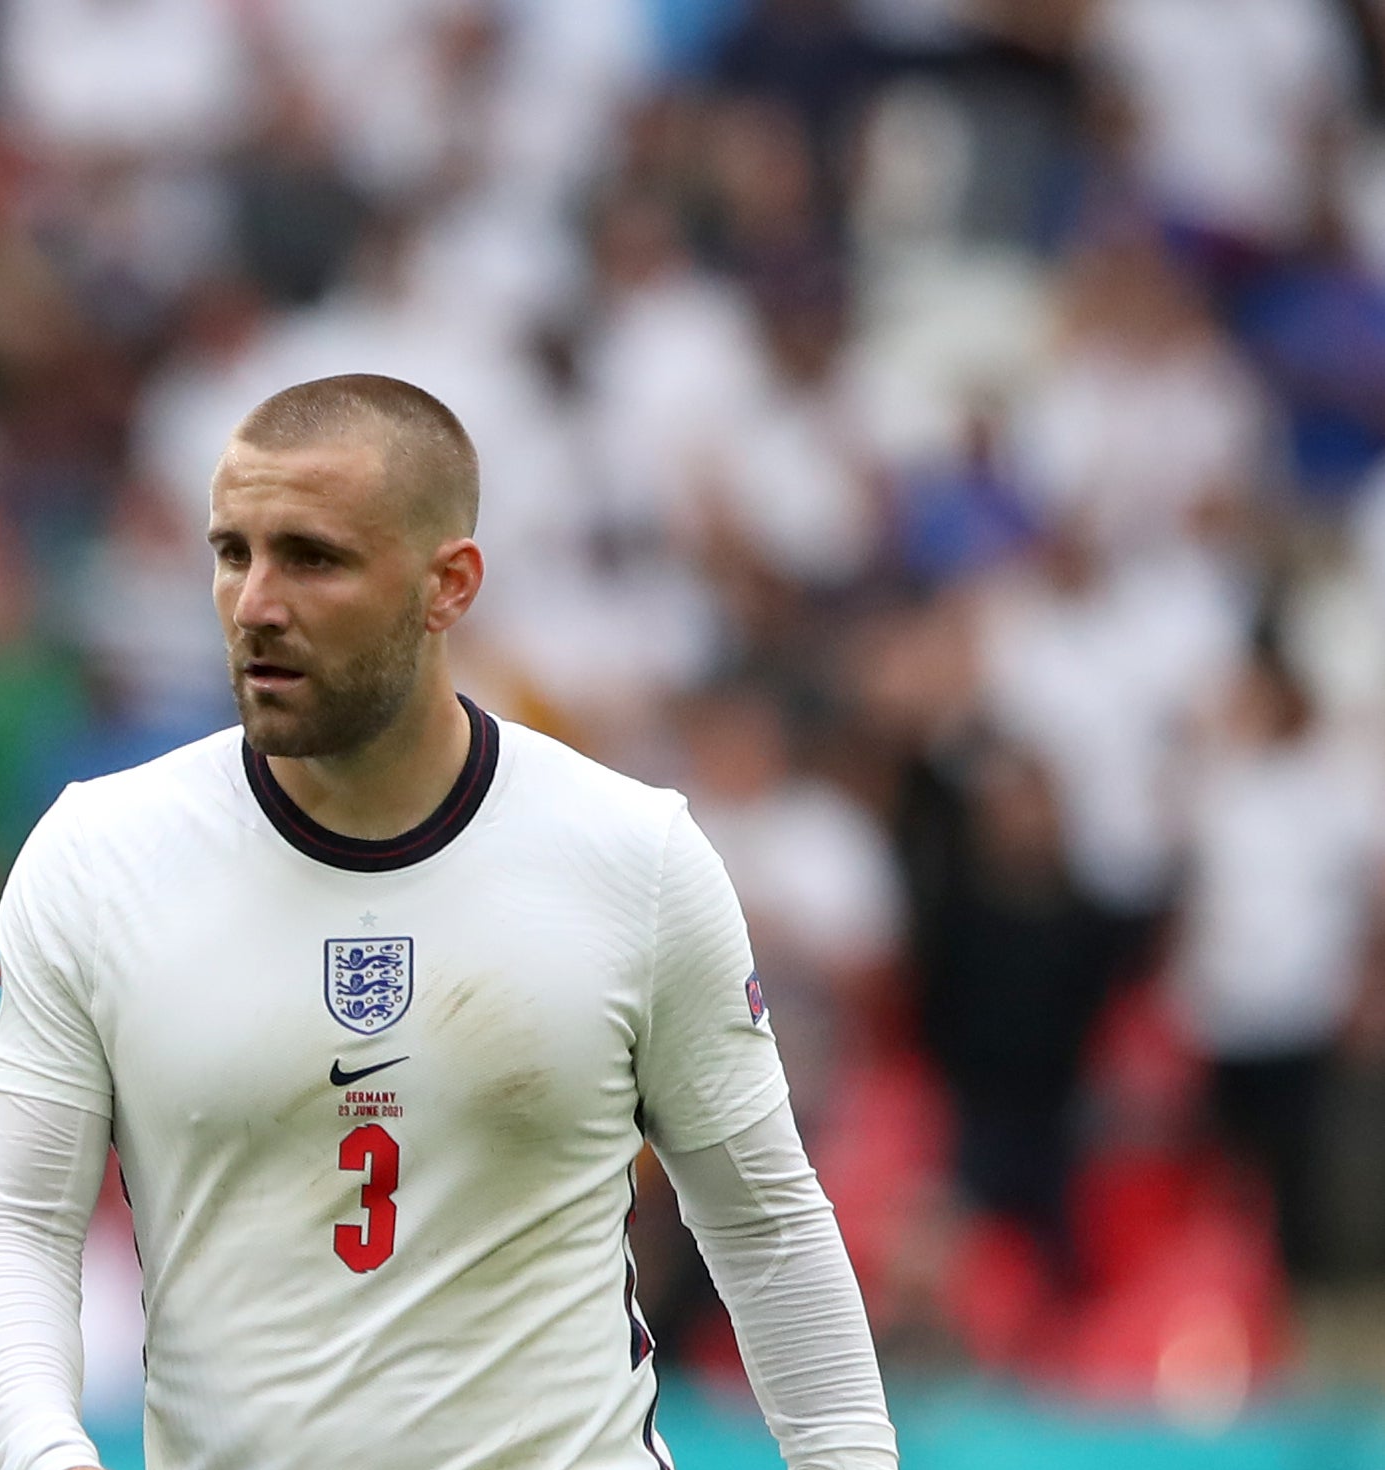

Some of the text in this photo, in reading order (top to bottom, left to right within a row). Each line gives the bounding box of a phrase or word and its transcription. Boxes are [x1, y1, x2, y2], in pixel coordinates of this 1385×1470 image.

[346, 1092, 396, 1103] GERMANY
[353, 1105, 380, 1118] JUNE
[333, 1123, 400, 1274] 3
